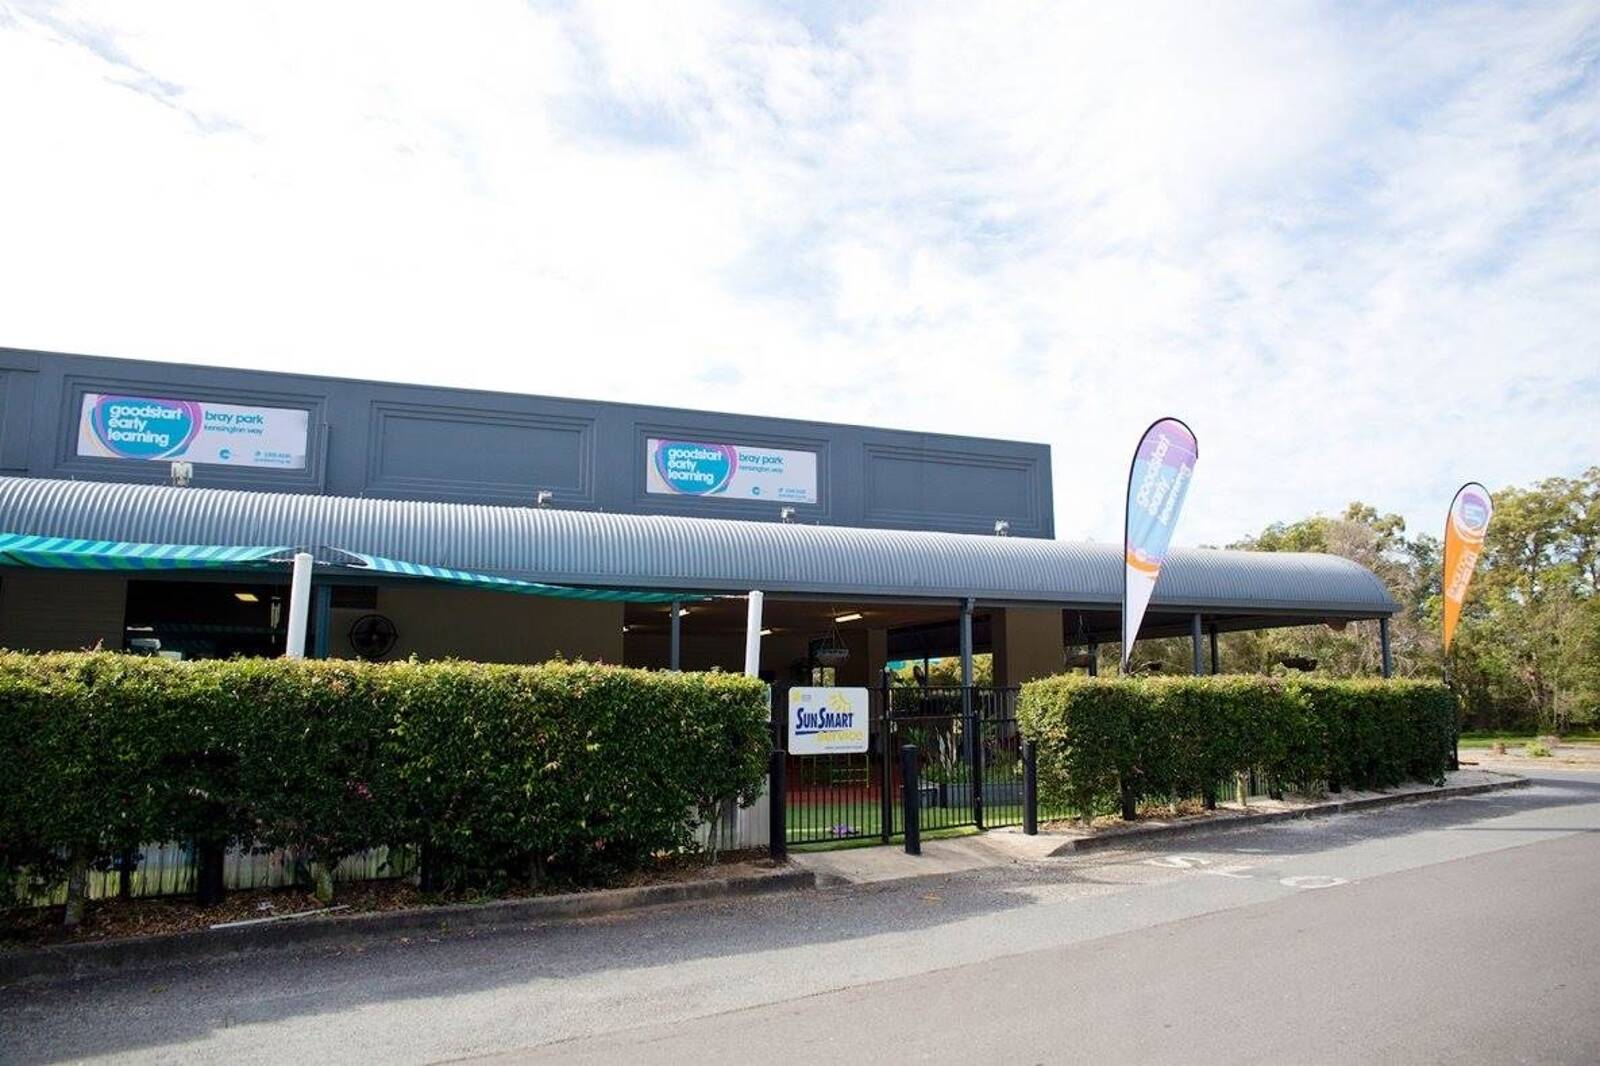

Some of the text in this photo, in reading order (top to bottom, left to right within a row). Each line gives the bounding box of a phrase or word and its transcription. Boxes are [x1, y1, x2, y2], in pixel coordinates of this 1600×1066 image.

[109, 403, 183, 420] goodstart
[204, 410, 264, 425] bray park
[108, 417, 148, 432] early
[204, 424, 263, 435] kensington way
[107, 428, 169, 445] learning
[667, 448, 722, 461] goodstart
[739, 453, 784, 466] bray park
[667, 459, 698, 471] early
[1136, 433, 1171, 508] goodstart
[667, 469, 714, 484] learning
[1148, 476, 1171, 516] early
[1159, 462, 1192, 526] learning
